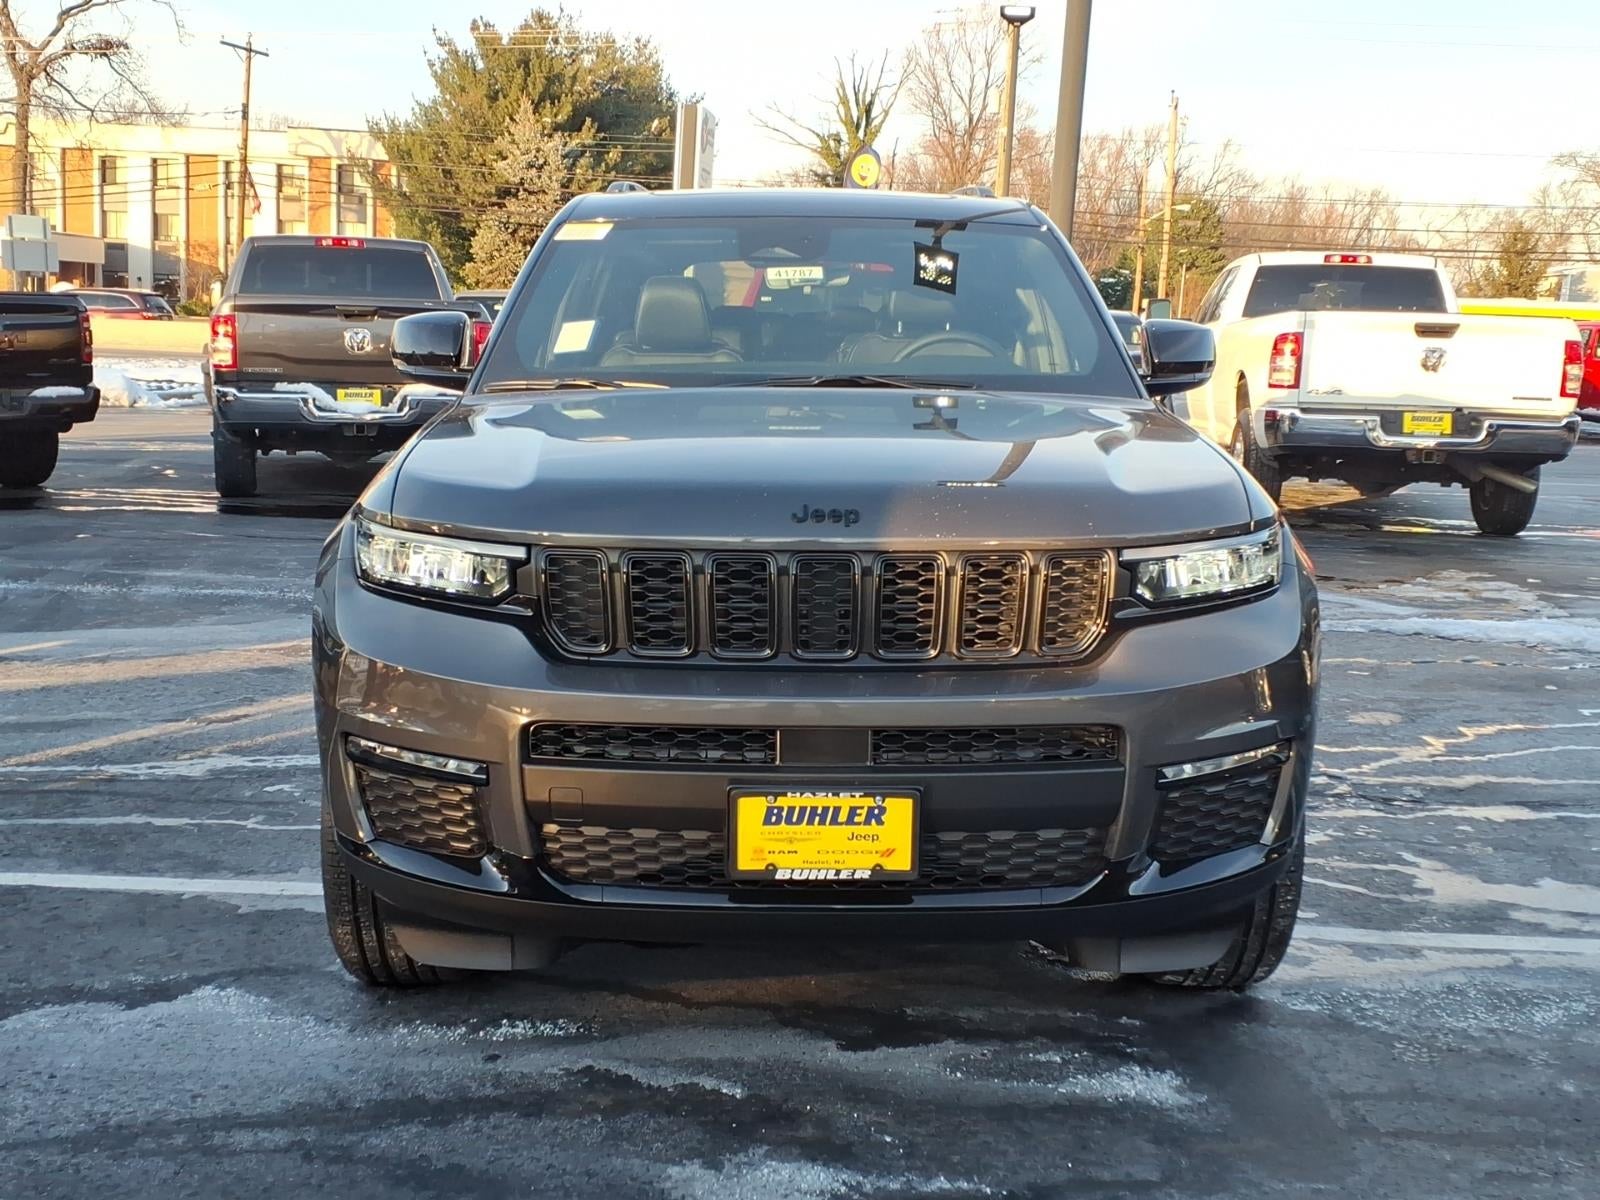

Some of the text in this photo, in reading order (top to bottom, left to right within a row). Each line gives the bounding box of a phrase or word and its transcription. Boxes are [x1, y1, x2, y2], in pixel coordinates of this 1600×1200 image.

[775, 269, 813, 278] 41787
[791, 503, 860, 528] Jeep
[762, 805, 887, 827] BUHLER
[847, 832, 880, 843] Jeep
[774, 869, 872, 880] BUHLER
